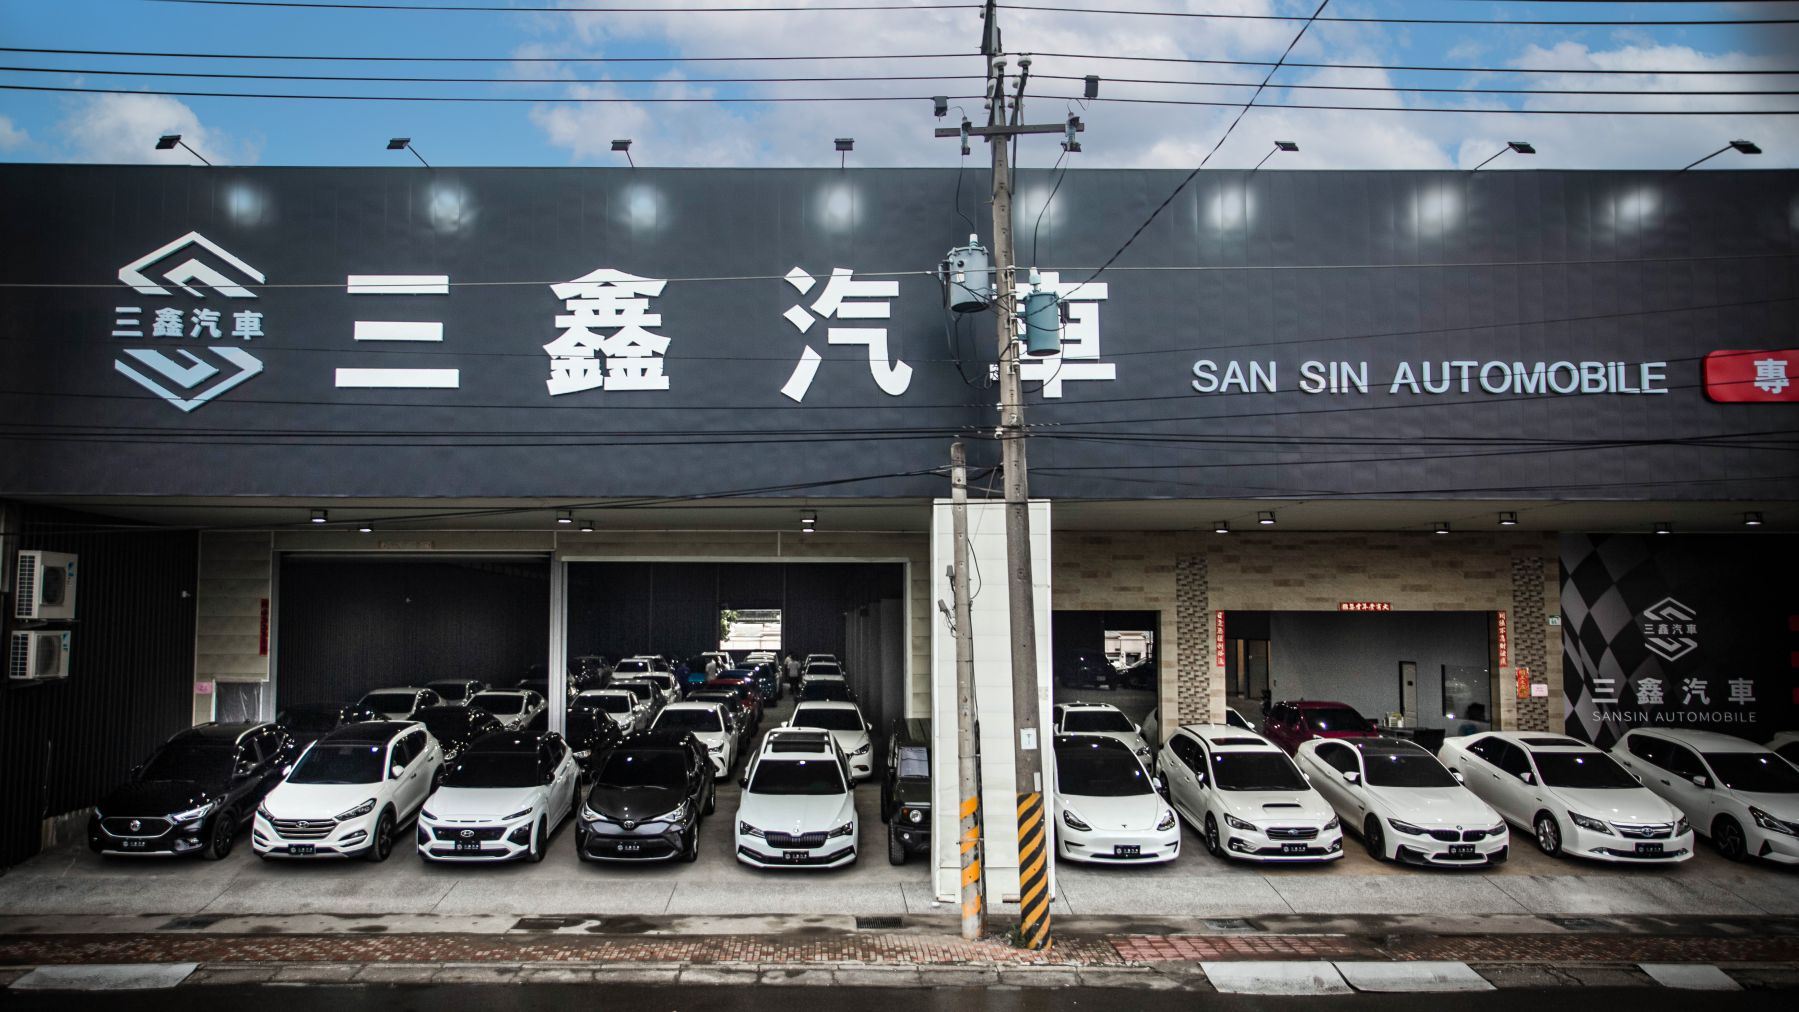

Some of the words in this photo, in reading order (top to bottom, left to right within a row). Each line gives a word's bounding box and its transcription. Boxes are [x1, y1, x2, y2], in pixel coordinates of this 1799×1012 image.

[112, 306, 265, 340] 三鑫汽車
[334, 266, 1117, 402] 三鑫汽車
[1191, 359, 1277, 393] SAN
[1299, 360, 1369, 394] SIN
[1389, 360, 1669, 394] AUTOMOBILE
[1753, 358, 1790, 394] 專
[1643, 623, 1698, 635] 三鑫汽車
[1591, 677, 1756, 705] 三鑫汽車
[1592, 711, 1649, 722] SANSIN
[1655, 711, 1757, 722] AUTOMOBILE
